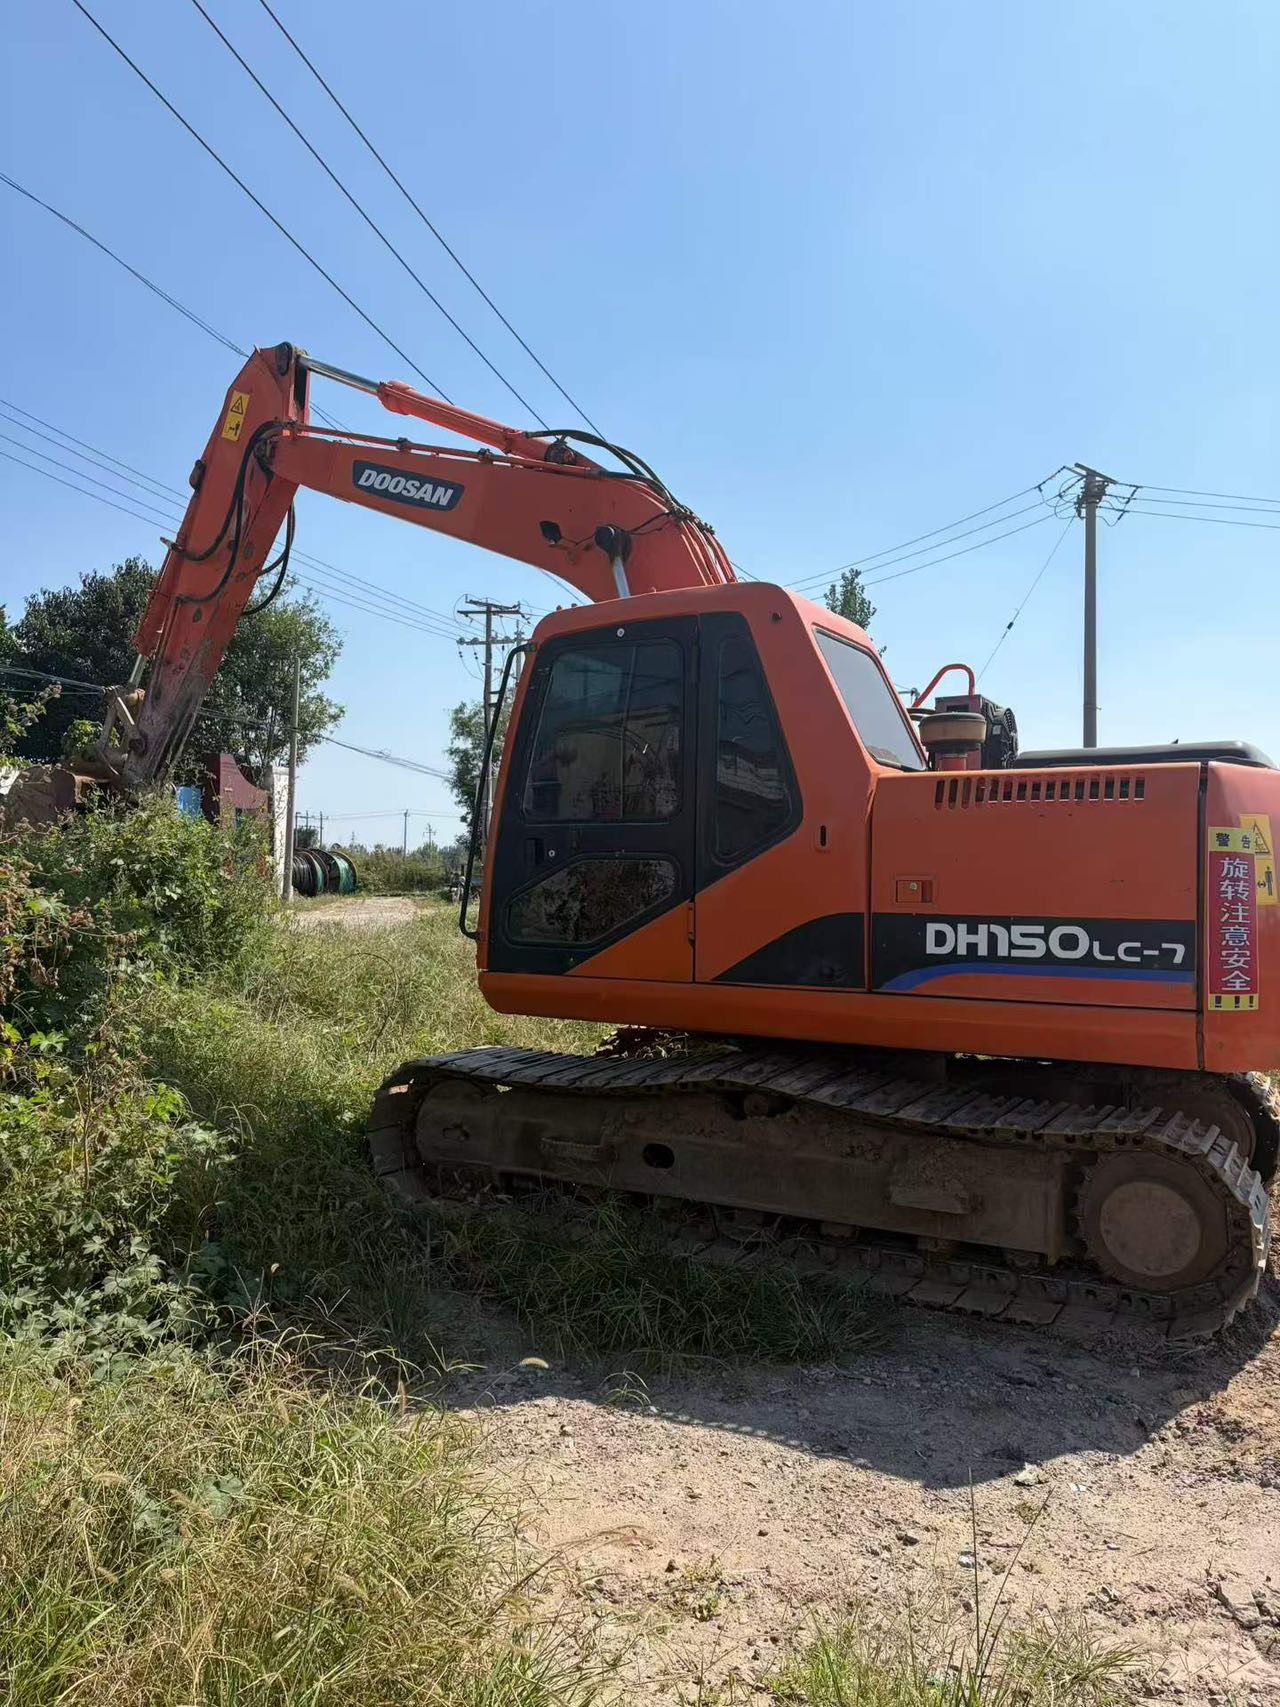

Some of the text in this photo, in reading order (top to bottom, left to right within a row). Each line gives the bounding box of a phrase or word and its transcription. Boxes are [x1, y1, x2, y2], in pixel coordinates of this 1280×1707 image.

[358, 469, 454, 506] DOOSAN
[1215, 832, 1251, 850] 警告
[1219, 857, 1251, 991] 旋转注意安全
